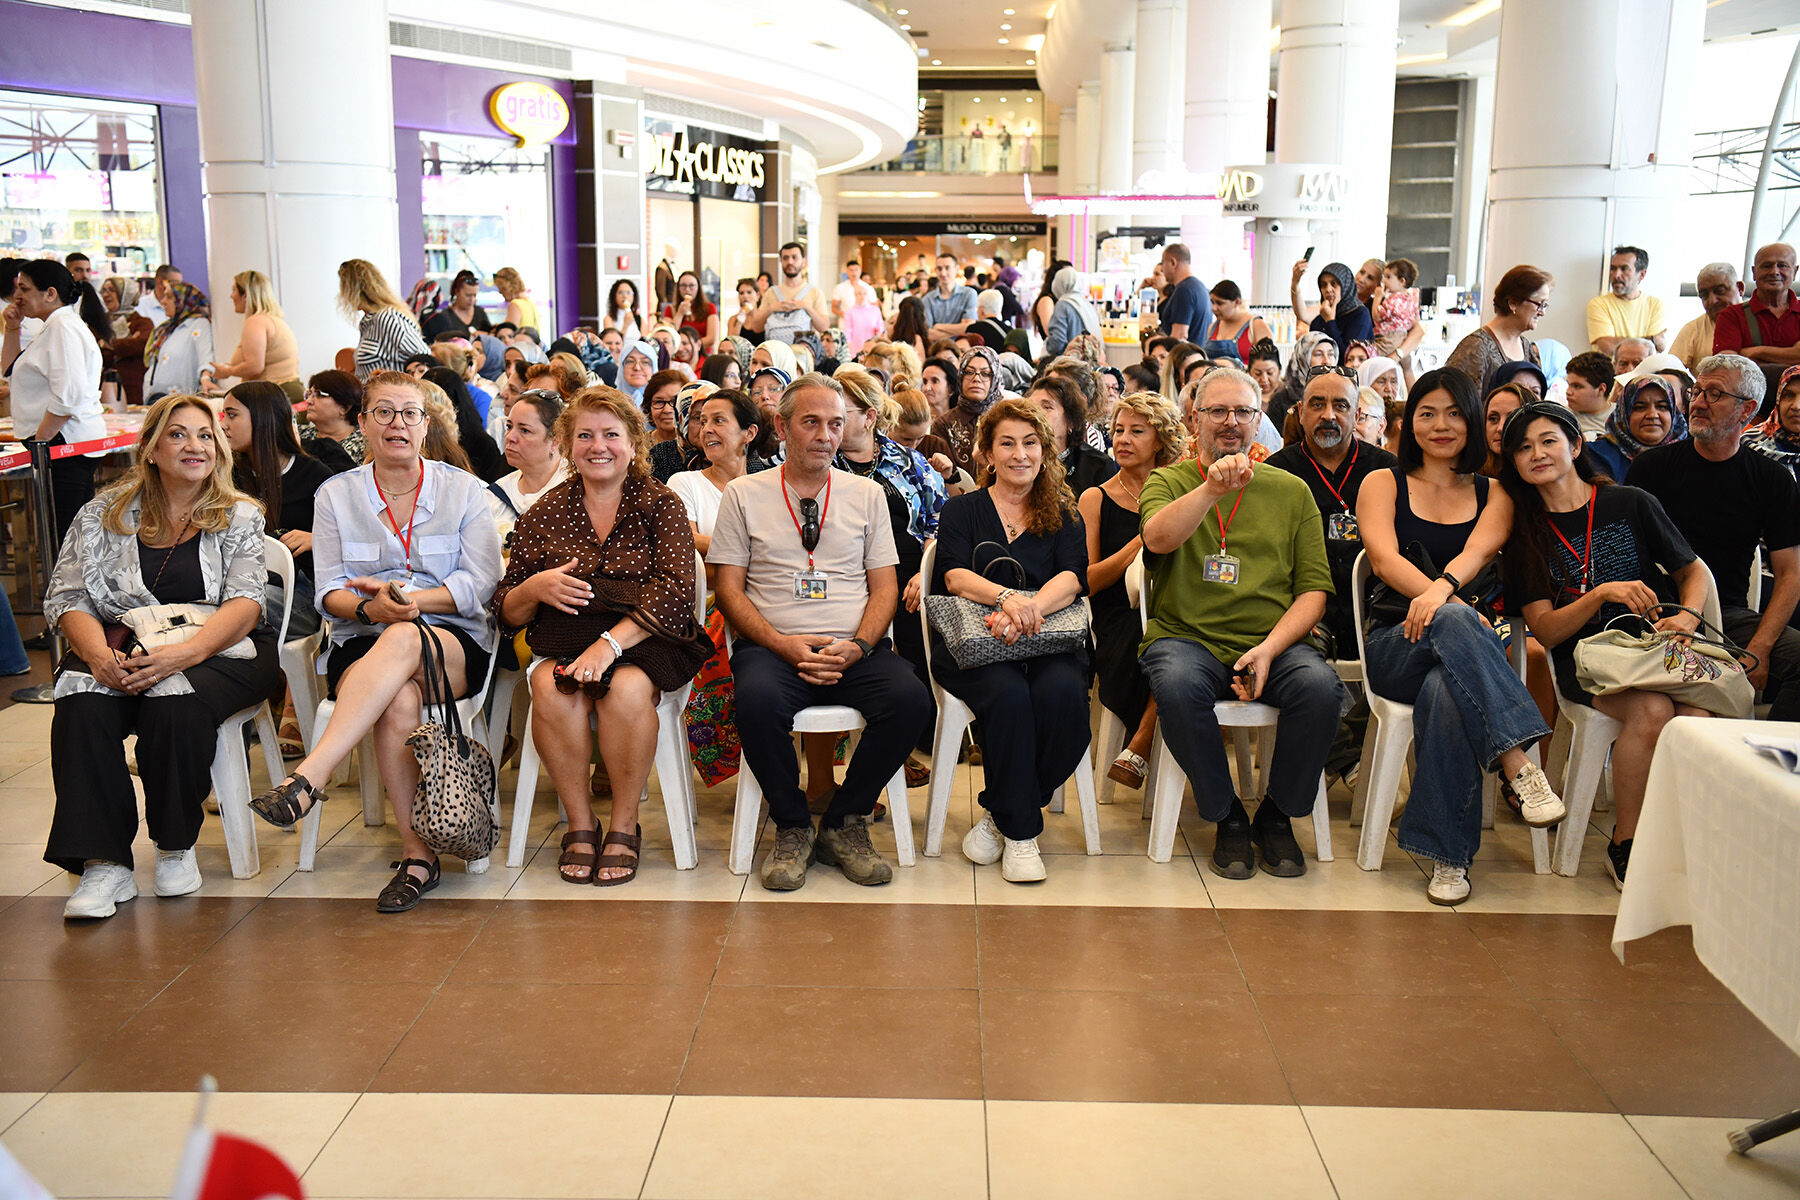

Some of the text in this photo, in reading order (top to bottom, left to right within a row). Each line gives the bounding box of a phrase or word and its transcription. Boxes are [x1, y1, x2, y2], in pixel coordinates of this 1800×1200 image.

[507, 93, 560, 123] gratis
[695, 141, 765, 188] CLASSICS
[946, 223, 1037, 233] MUDO COLLECTION
